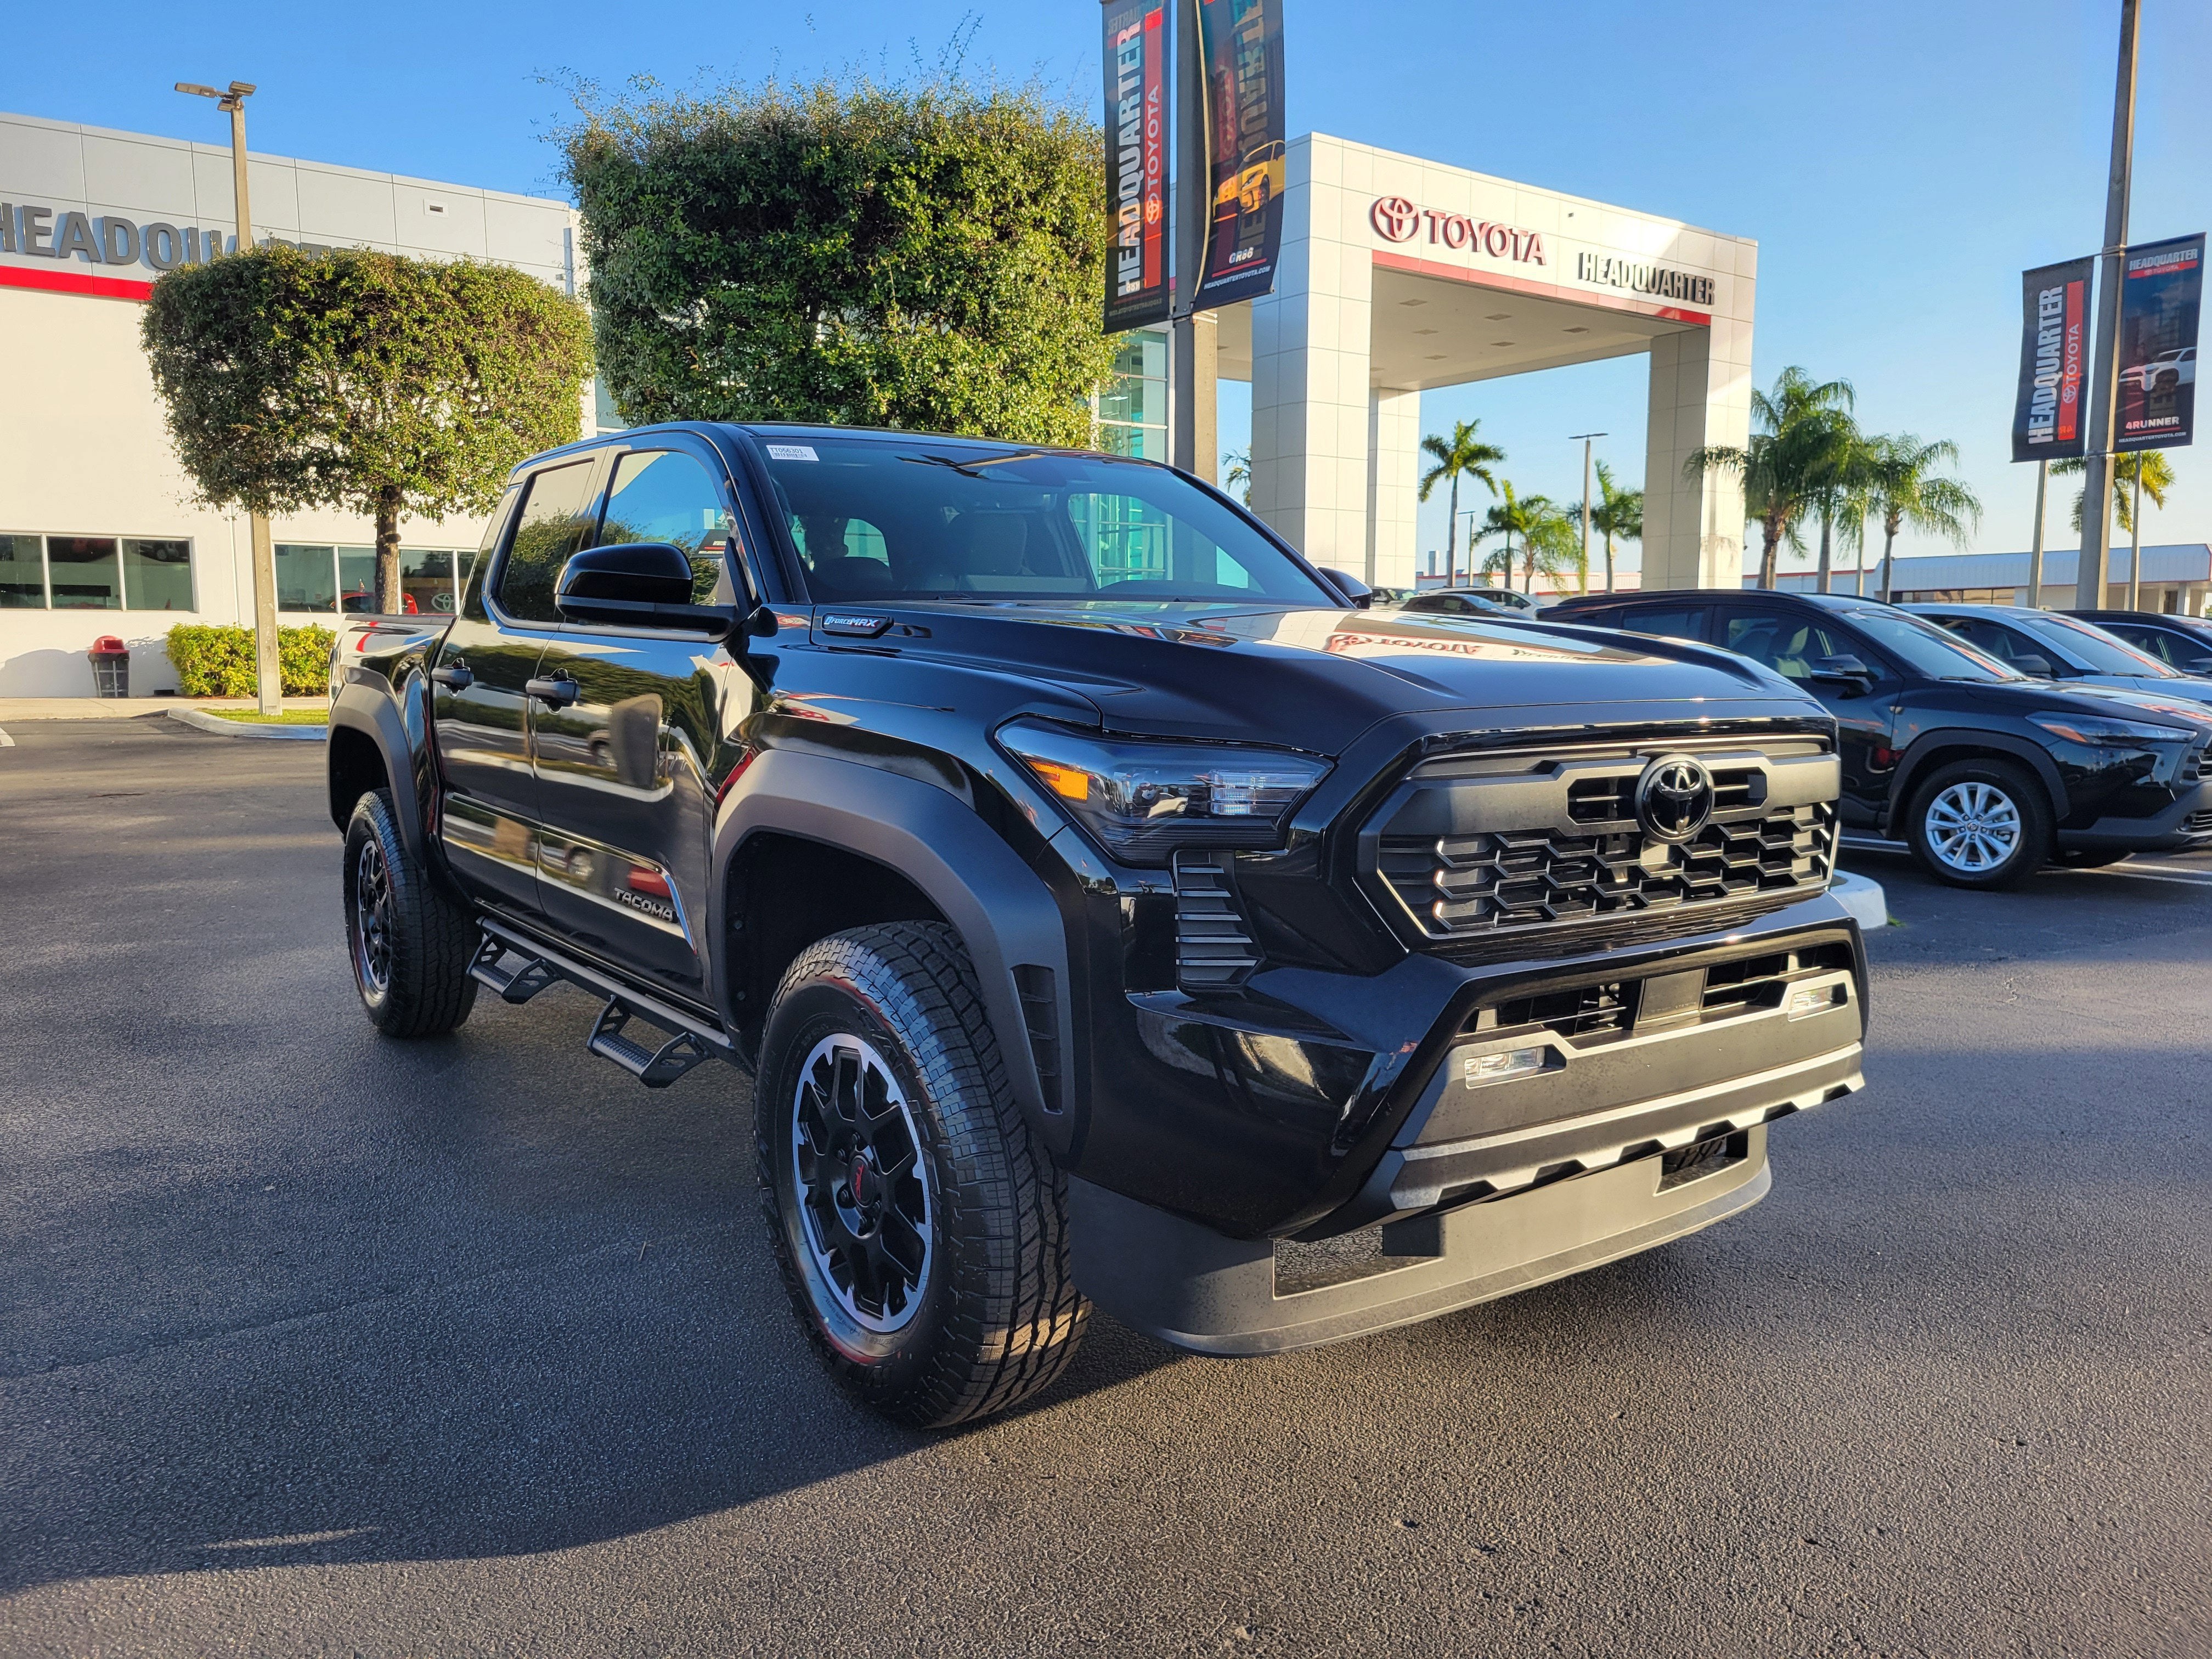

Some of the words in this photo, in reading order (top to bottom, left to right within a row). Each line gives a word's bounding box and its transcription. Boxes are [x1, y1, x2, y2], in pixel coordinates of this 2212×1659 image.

[1117, 20, 1144, 297] HEADQUARTER
[1147, 84, 1159, 189] TOYOTA
[1229, 247, 1254, 264] GR86
[1424, 209, 1547, 266] TOYOTA
[2129, 248, 2198, 271] HEADQUARTER
[1578, 252, 1716, 305] HEADQUARTER
[2153, 264, 2179, 274] TOYOTA
[2028, 286, 2063, 444] HEADQUARTER
[2065, 323, 2079, 383] TOYOTA
[2125, 416, 2180, 430] 4RUNNER
[614, 887, 674, 922] TACOMA
